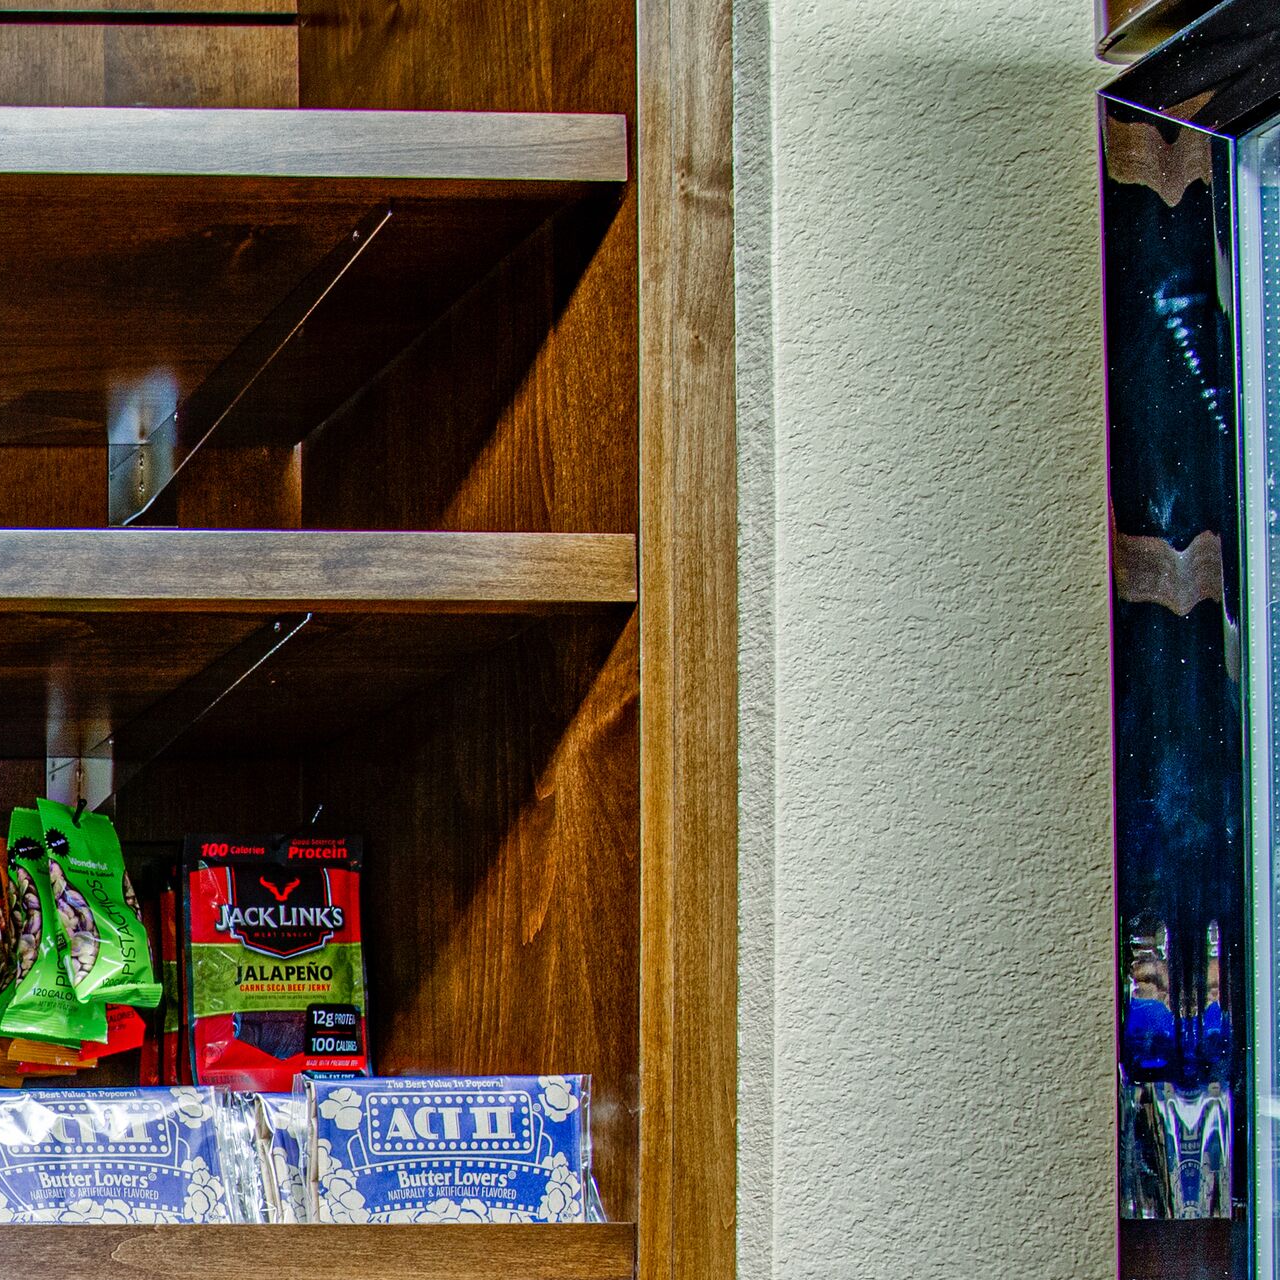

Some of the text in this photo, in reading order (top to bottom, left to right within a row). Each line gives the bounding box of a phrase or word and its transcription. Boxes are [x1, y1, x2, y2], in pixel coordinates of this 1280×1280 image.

[201, 842, 265, 857] 100 Calories
[287, 845, 348, 860] Protein
[215, 904, 344, 931] JACK LINK'S
[85, 879, 135, 977] PISTACHIOS
[234, 961, 333, 986] JALAPEÑO
[239, 983, 332, 993] CARNE SECA BEEF JERKY
[311, 1037, 335, 1053] 100
[385, 1078, 504, 1090] The Best Value In Popcorn!
[38, 1090, 60, 1099] Best
[61, 1090, 87, 1100] Value
[98, 1089, 138, 1100] Popcorn!
[385, 1105, 516, 1140] ACT II
[38, 1169, 149, 1189] Butter Lovers
[397, 1169, 509, 1188] Butter Lovers
[29, 1186, 160, 1202] NATURALLY & ARTIFICIALLY FLAVORED
[387, 1186, 517, 1200] NATURALLY & ARTIFICIALLY FLAVORED
